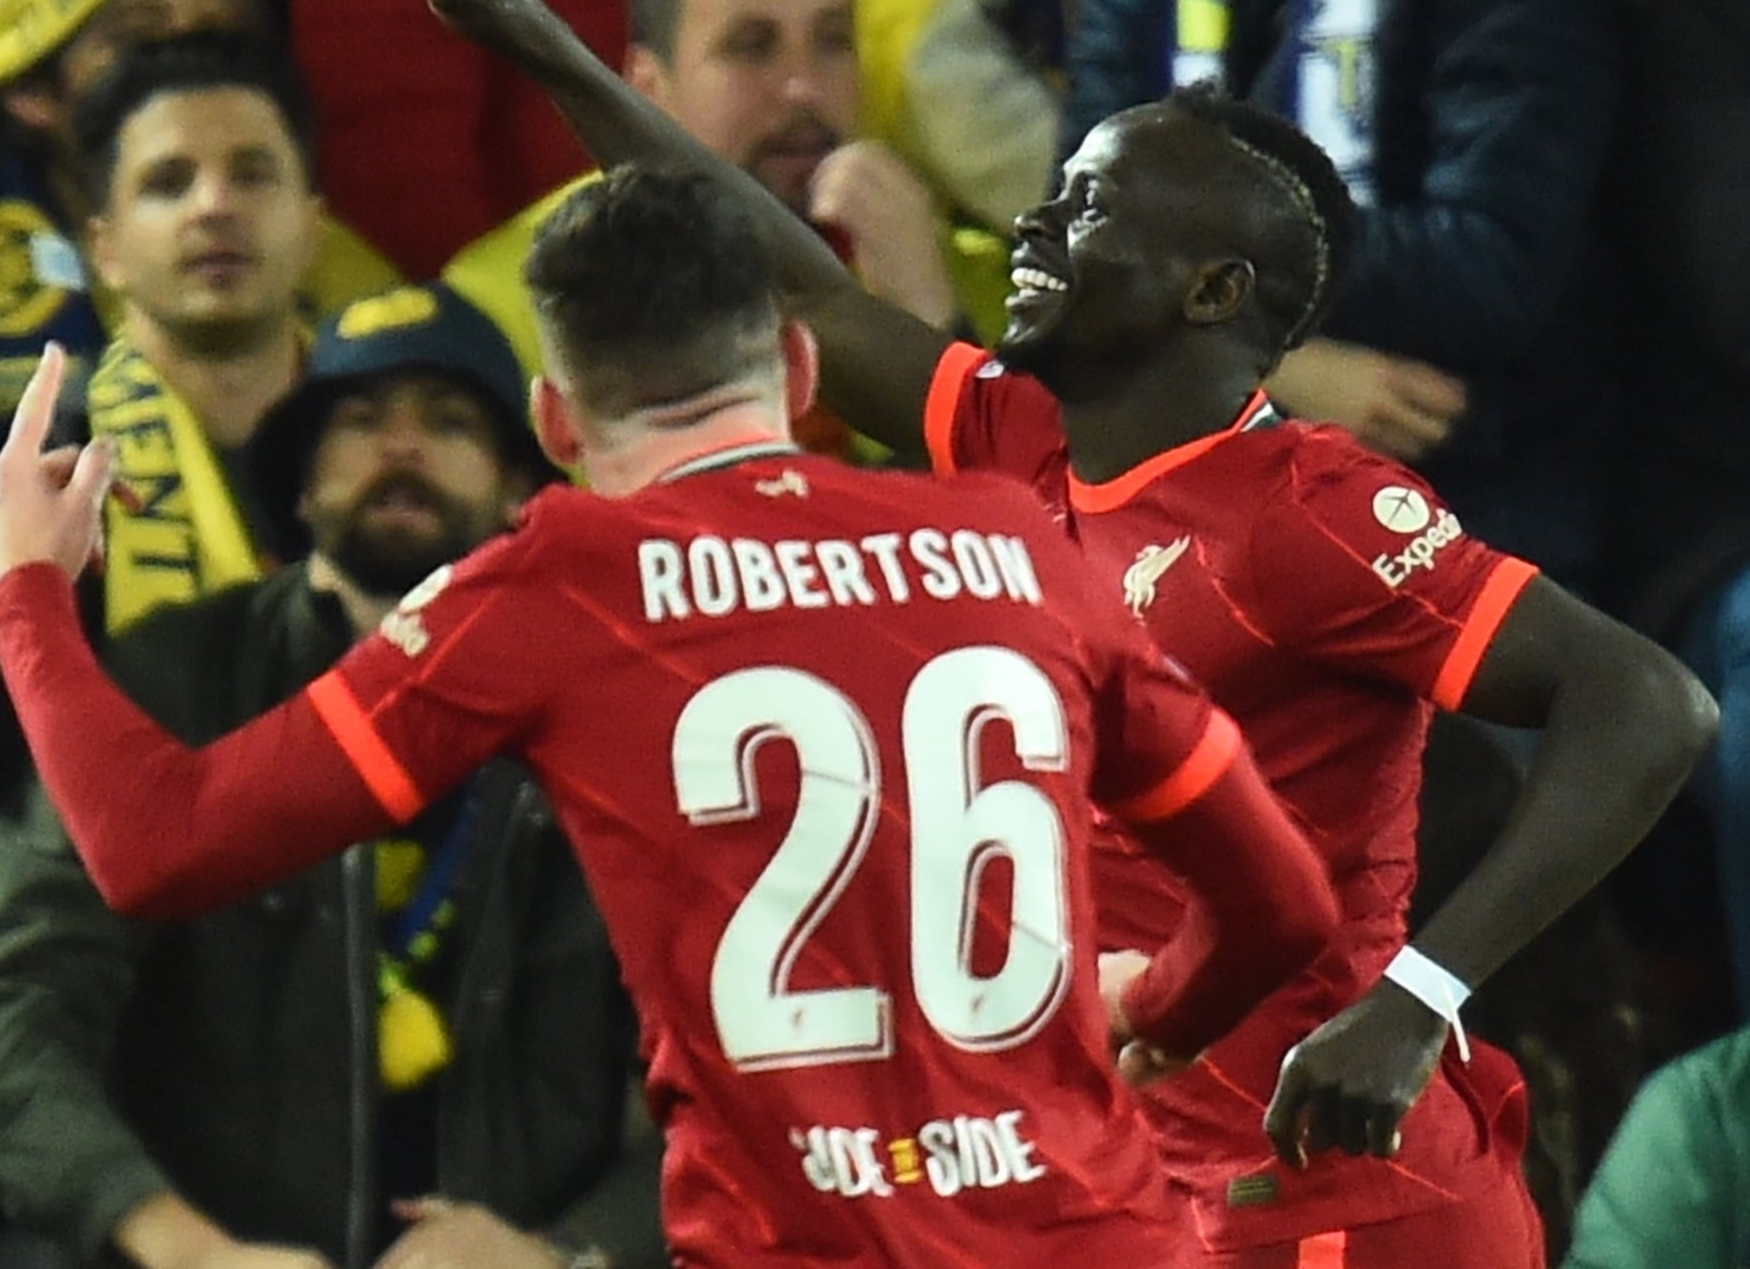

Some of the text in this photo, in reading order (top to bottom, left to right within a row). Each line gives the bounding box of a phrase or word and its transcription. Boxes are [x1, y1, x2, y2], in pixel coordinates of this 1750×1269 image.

[638, 528, 1044, 622] ROBERTSON
[671, 645, 1074, 1074] 26
[918, 1109, 1047, 1198] SIDE
